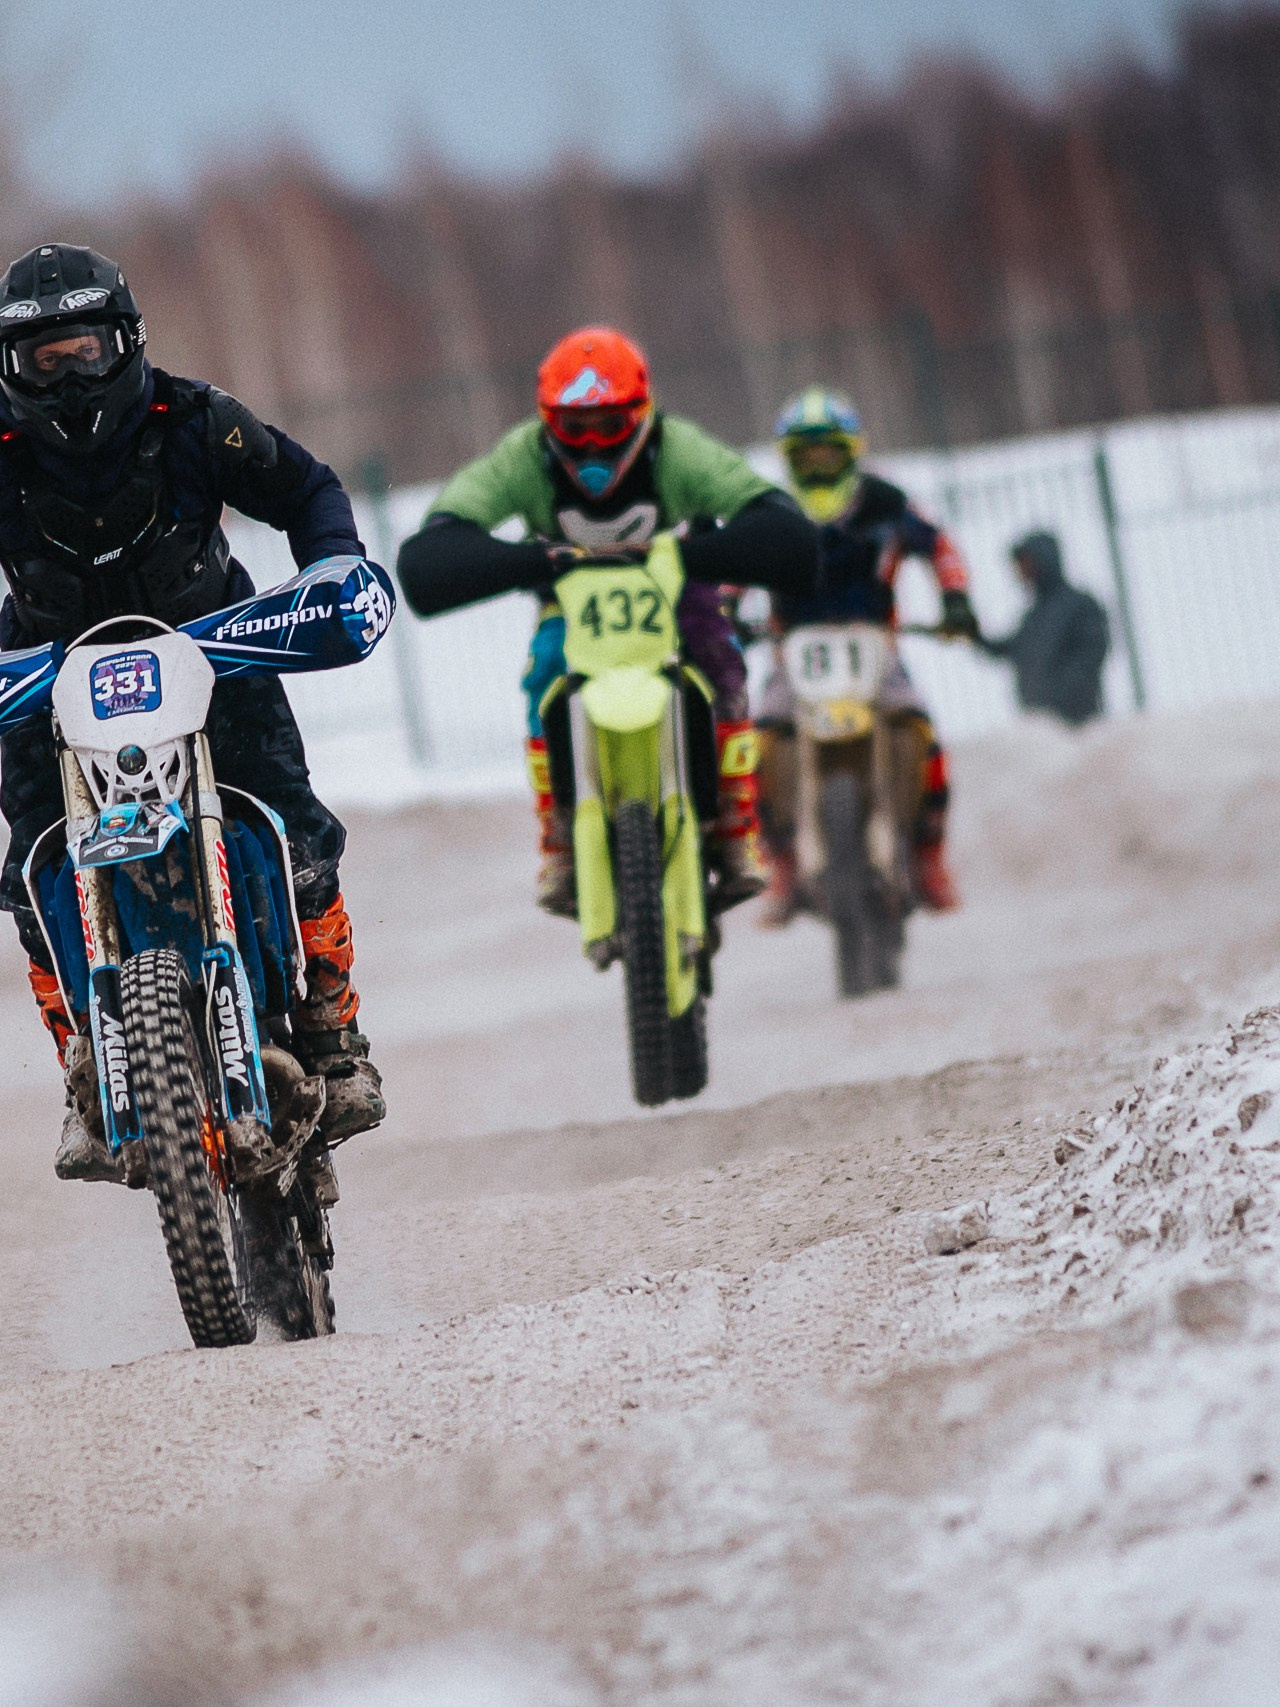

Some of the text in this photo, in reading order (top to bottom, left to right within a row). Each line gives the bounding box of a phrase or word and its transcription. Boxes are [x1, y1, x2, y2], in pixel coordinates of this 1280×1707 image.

[0, 304, 34, 318] Airoh
[65, 290, 107, 310] Airoh
[216, 604, 333, 640] FEDOROV
[580, 588, 663, 638] 432
[803, 640, 861, 679] 81
[95, 669, 156, 701] 331
[214, 985, 249, 1087] Mitas
[101, 1011, 130, 1113] Mitas
